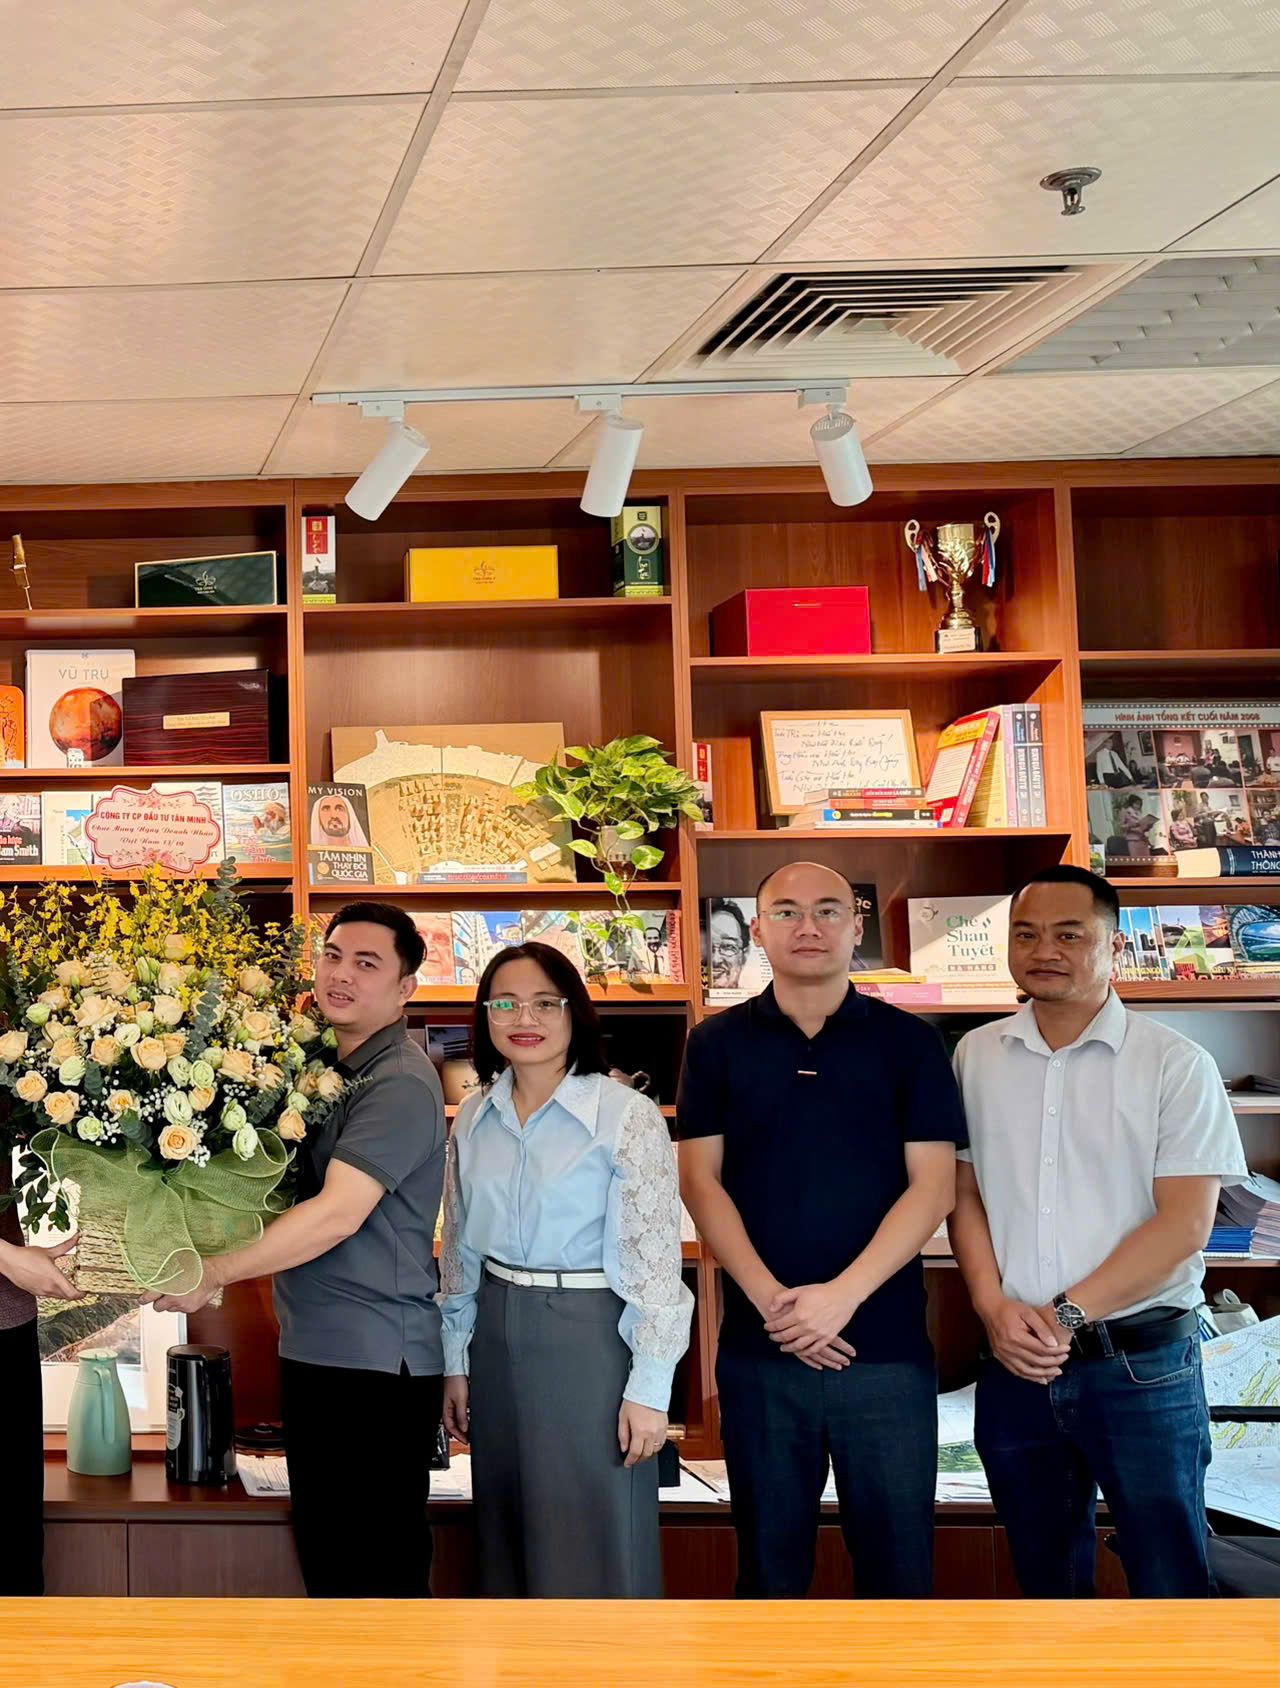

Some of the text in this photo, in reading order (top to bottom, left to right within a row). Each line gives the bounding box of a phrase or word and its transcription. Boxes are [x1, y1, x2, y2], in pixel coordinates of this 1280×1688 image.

[230, 788, 280, 801] OSHO
[308, 786, 363, 797] MY VISION
[100, 810, 120, 820] CÔNG
[132, 812, 142, 820] CP
[186, 814, 207, 823] MINH
[14, 845, 38, 856] Smith
[354, 870, 368, 878] GIA
[947, 929, 988, 942] Shan
[947, 943, 995, 960] Tuyết
